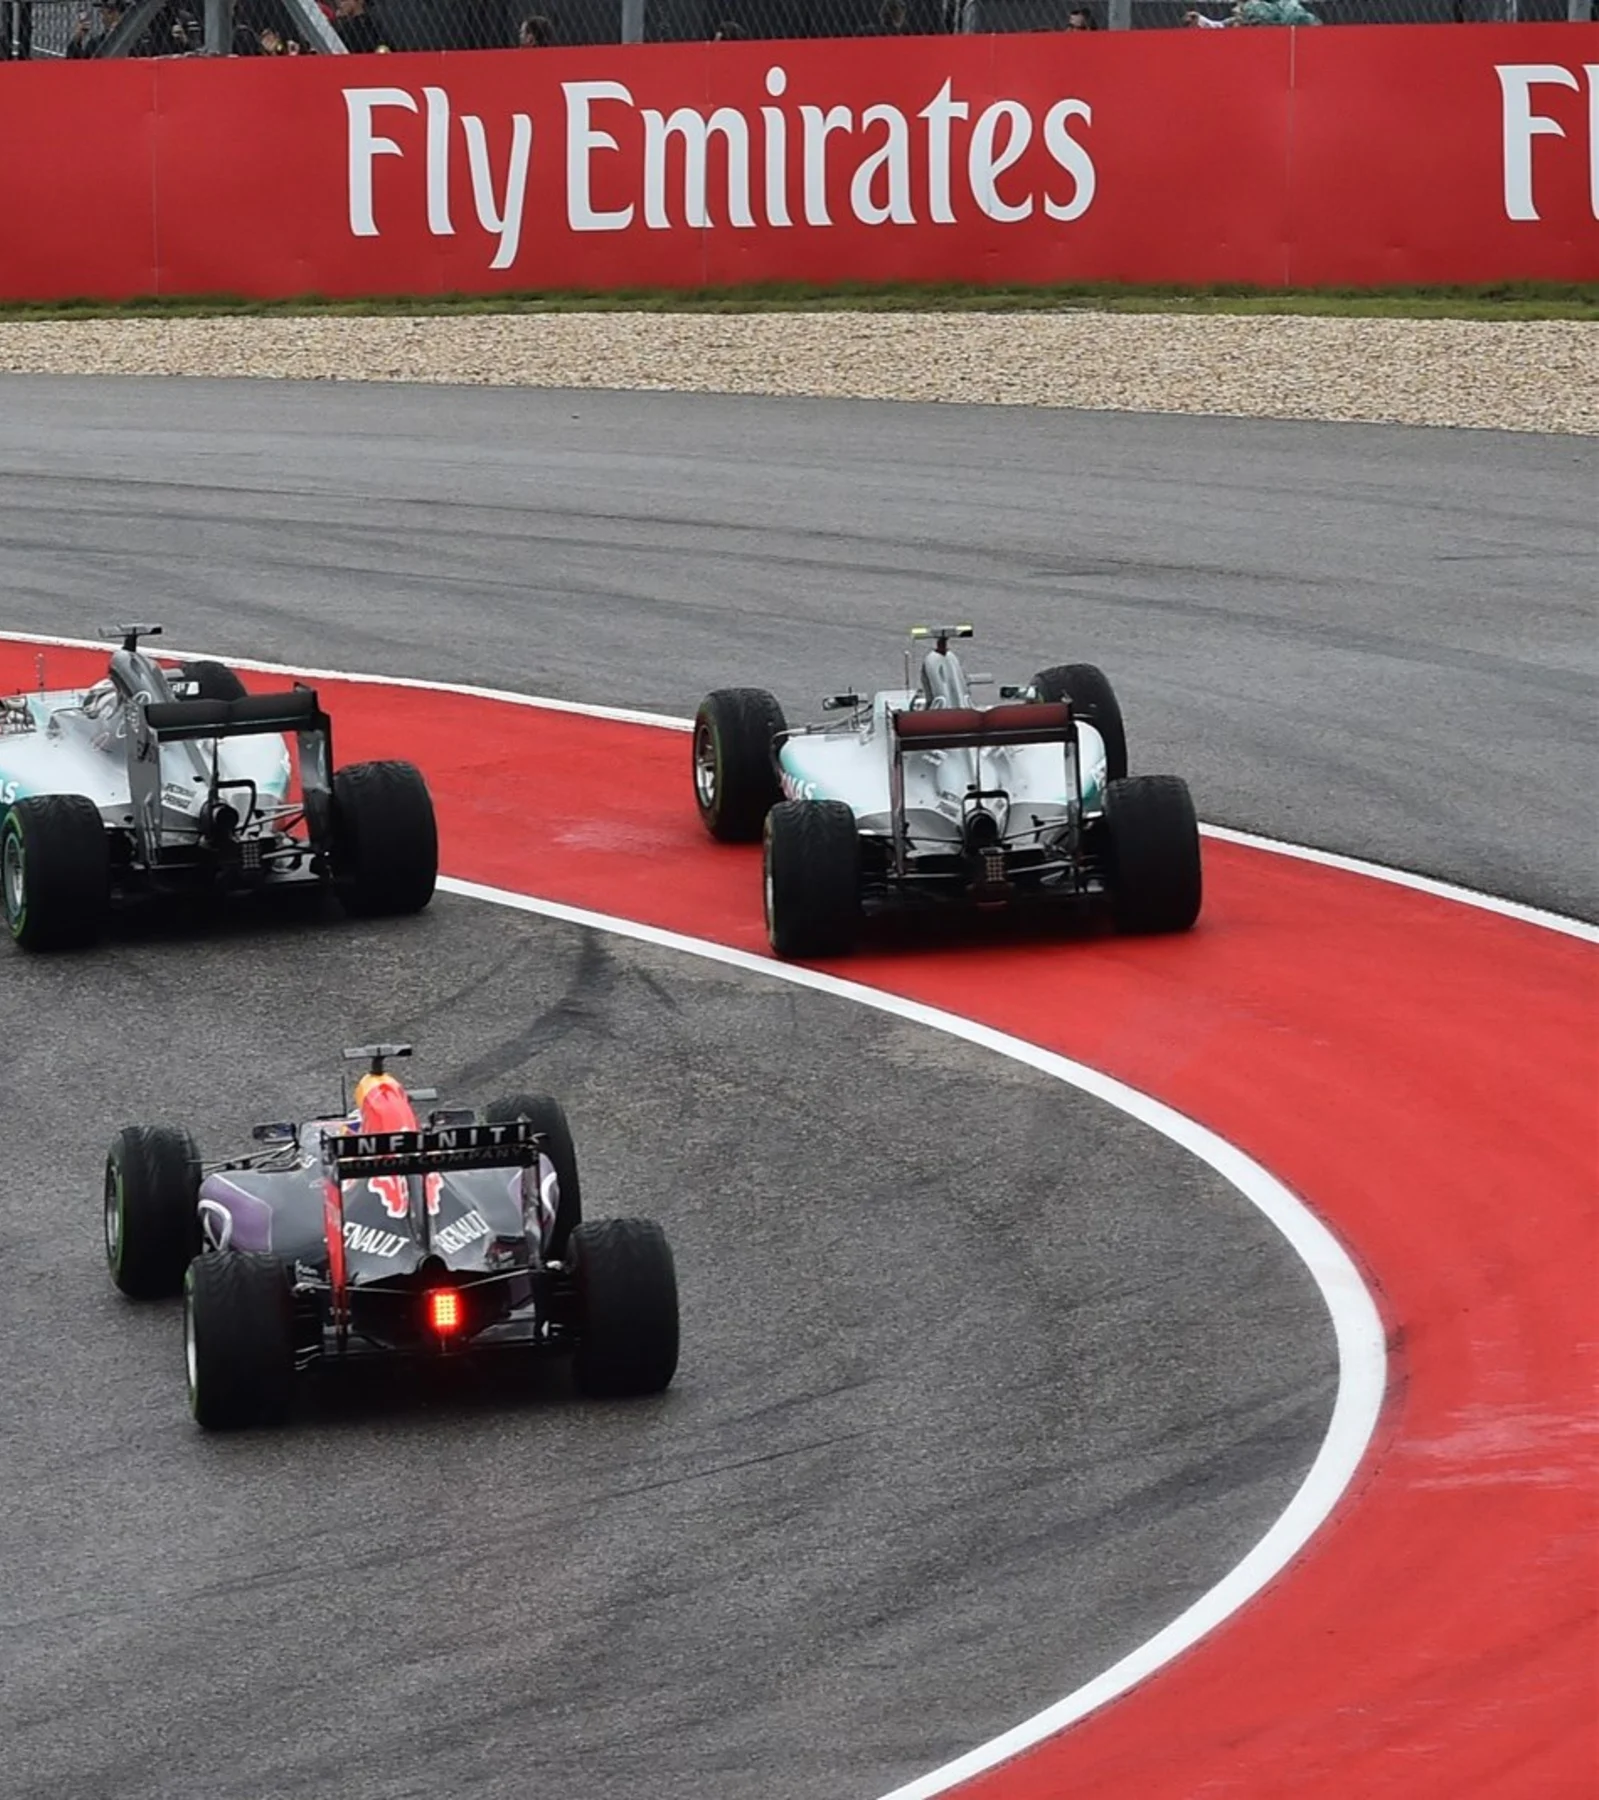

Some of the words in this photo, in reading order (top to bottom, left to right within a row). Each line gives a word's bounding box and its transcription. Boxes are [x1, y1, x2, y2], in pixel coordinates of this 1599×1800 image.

[341, 86, 532, 269] Fly
[561, 66, 1096, 231] Emirates
[337, 1125, 525, 1155] INFINITI
[343, 1221, 410, 1258] ENAULT
[433, 1209, 491, 1255] RENAULT
